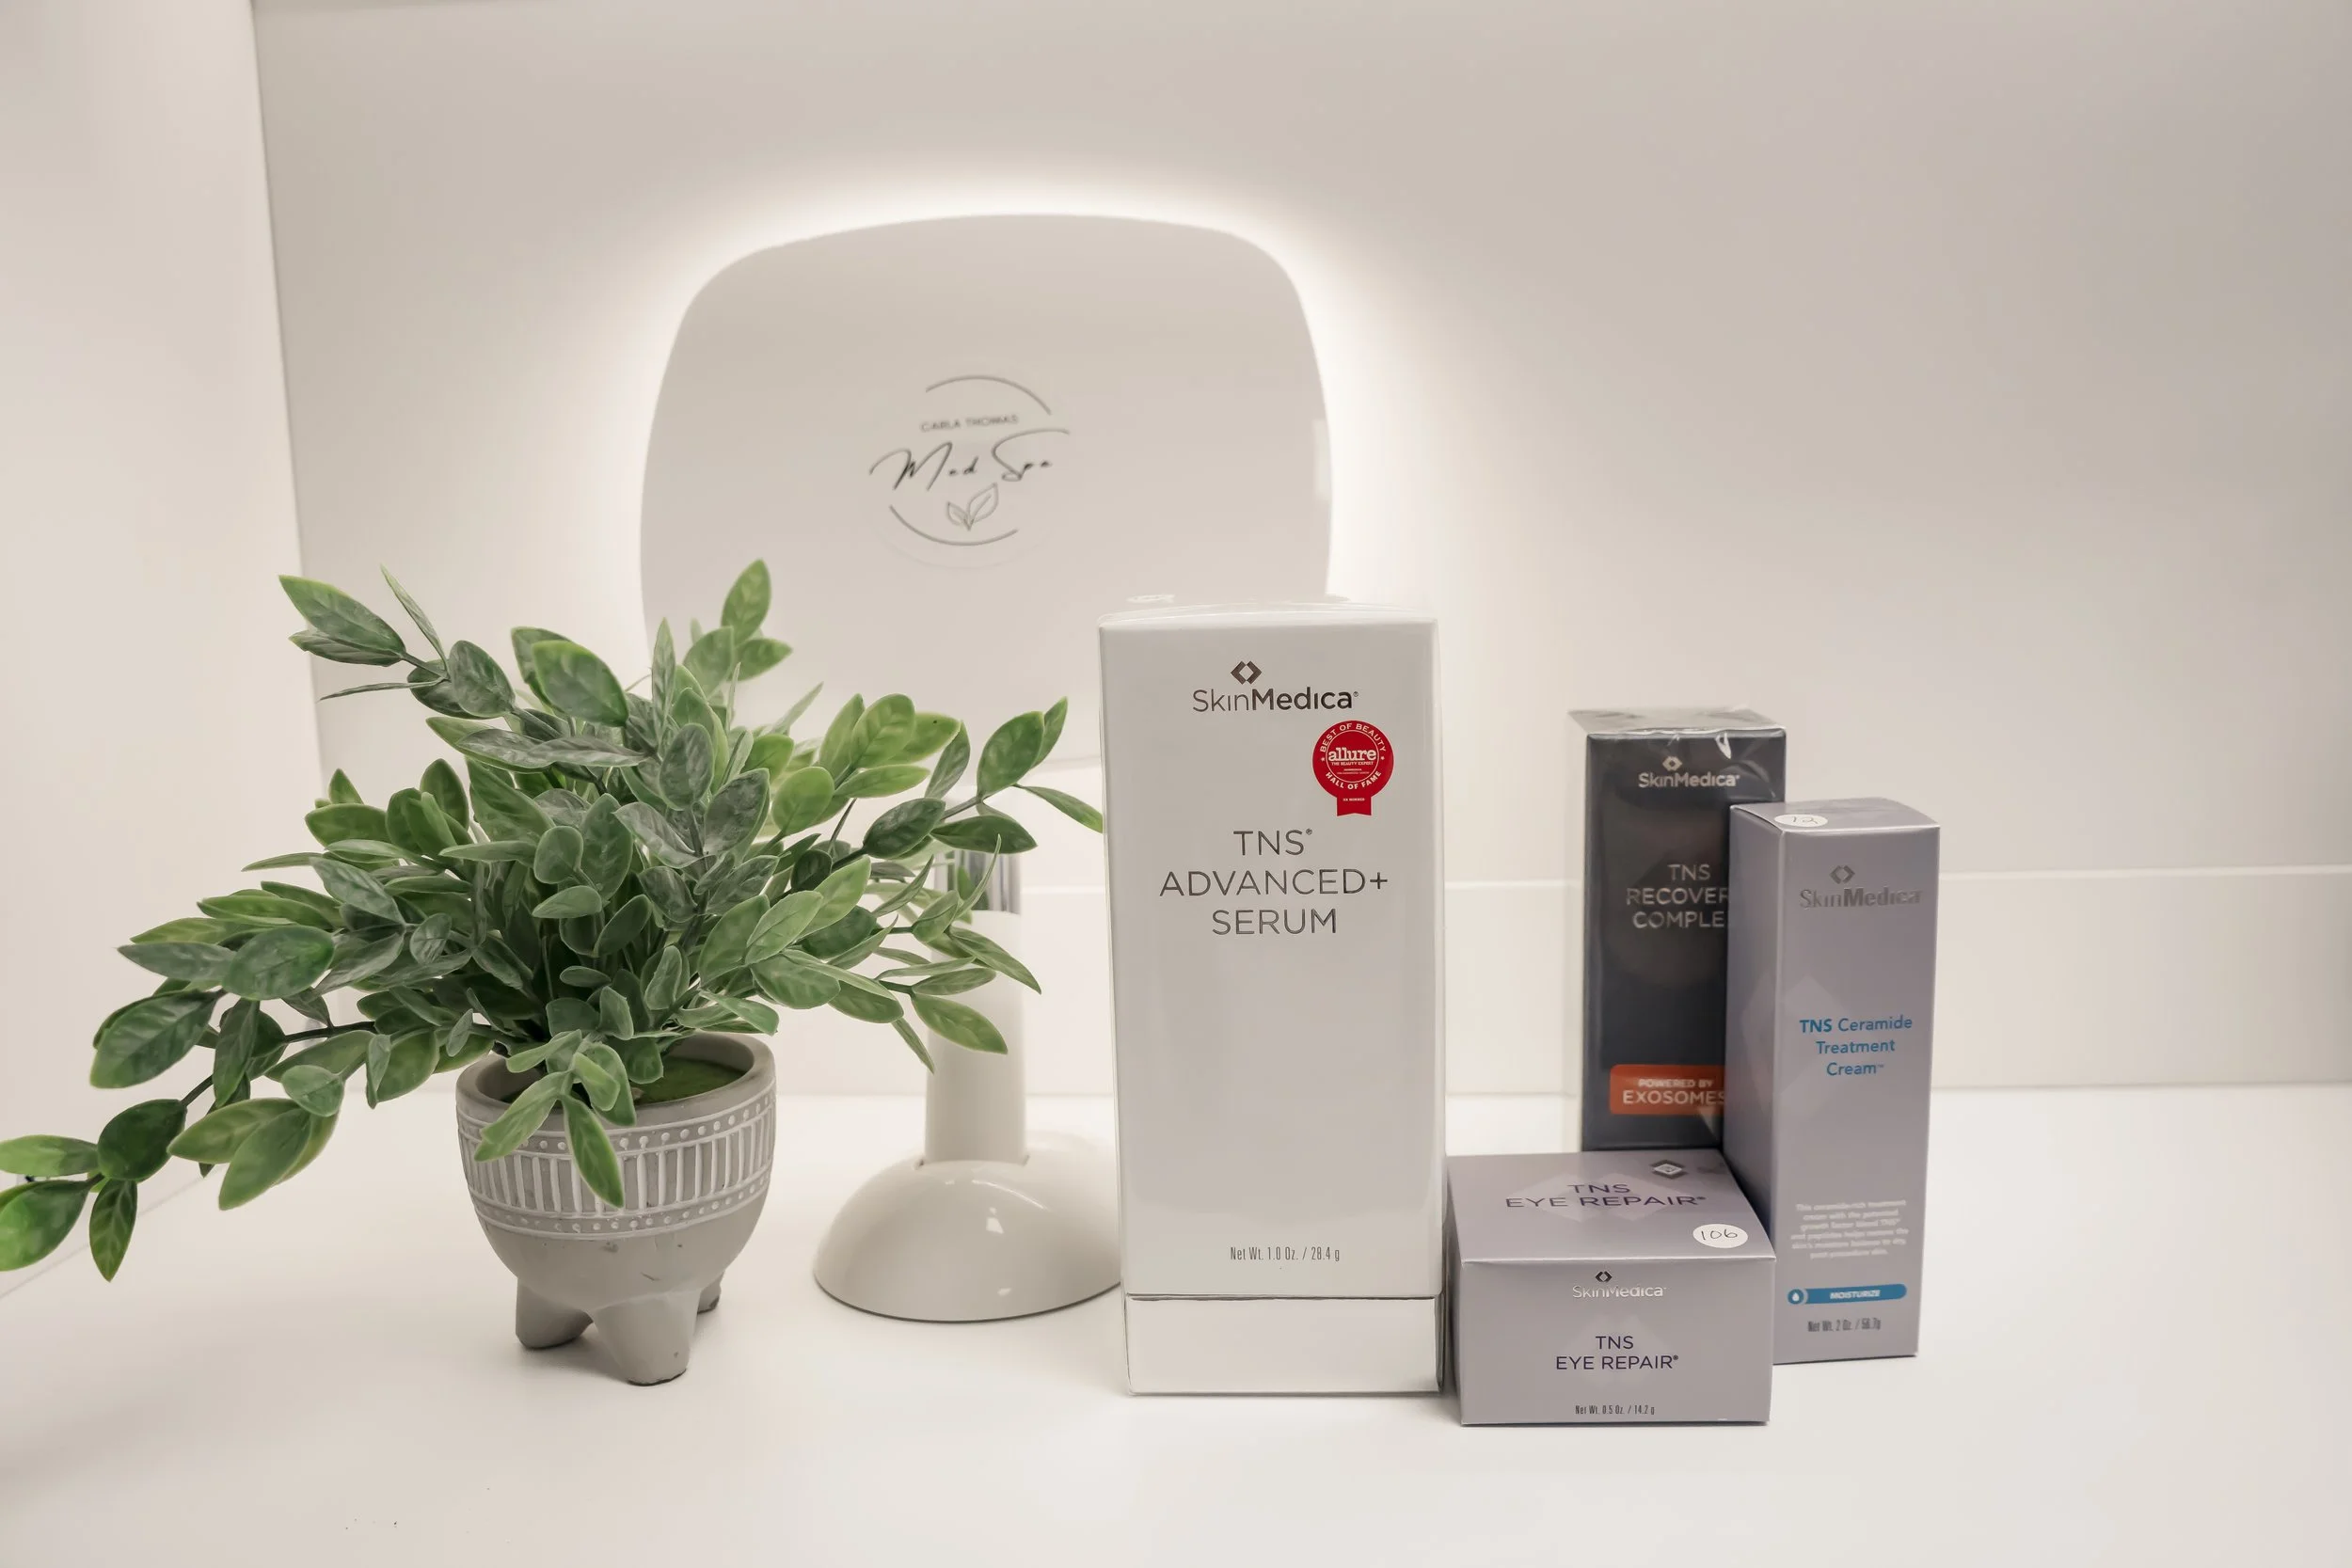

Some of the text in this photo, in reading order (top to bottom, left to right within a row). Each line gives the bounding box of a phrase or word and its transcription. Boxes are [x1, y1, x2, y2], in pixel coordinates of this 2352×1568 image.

[964, 414, 1020, 427] THOMAS
[869, 428, 1071, 491] Med Spa
[1319, 722, 1387, 753] BEST OF BEAUTY
[1327, 747, 1377, 762] allure
[1325, 771, 1344, 789] HALL
[1360, 770, 1382, 788] FAME
[1666, 863, 1711, 881] TNS
[1159, 868, 1389, 896] ADVANCED+
[1212, 908, 1337, 936] SERUM
[1799, 1014, 1914, 1034] TNS Ceramide
[1816, 1038, 1897, 1055] Treatment
[1637, 1078, 1713, 1088] POWERED BY
[1567, 1183, 1630, 1195] TNS
[1505, 1196, 1569, 1208] EYE
[1701, 1228, 1739, 1241] 106
[1230, 1246, 1247, 1260] Net
[1248, 1246, 1264, 1260] Wt.
[1267, 1246, 1281, 1260] 1.0
[1301, 1246, 1308, 1260] /
[1311, 1246, 1331, 1260] 28.4
[1334, 1249, 1340, 1262] g
[1829, 1290, 1882, 1300] MOISTURIZE
[1595, 1335, 1634, 1350] TNS
[1556, 1355, 1595, 1370] EYE
[1575, 1404, 1587, 1415] Net
[1601, 1404, 1613, 1415] 0.5
[1634, 1404, 1649, 1415] 14.2
